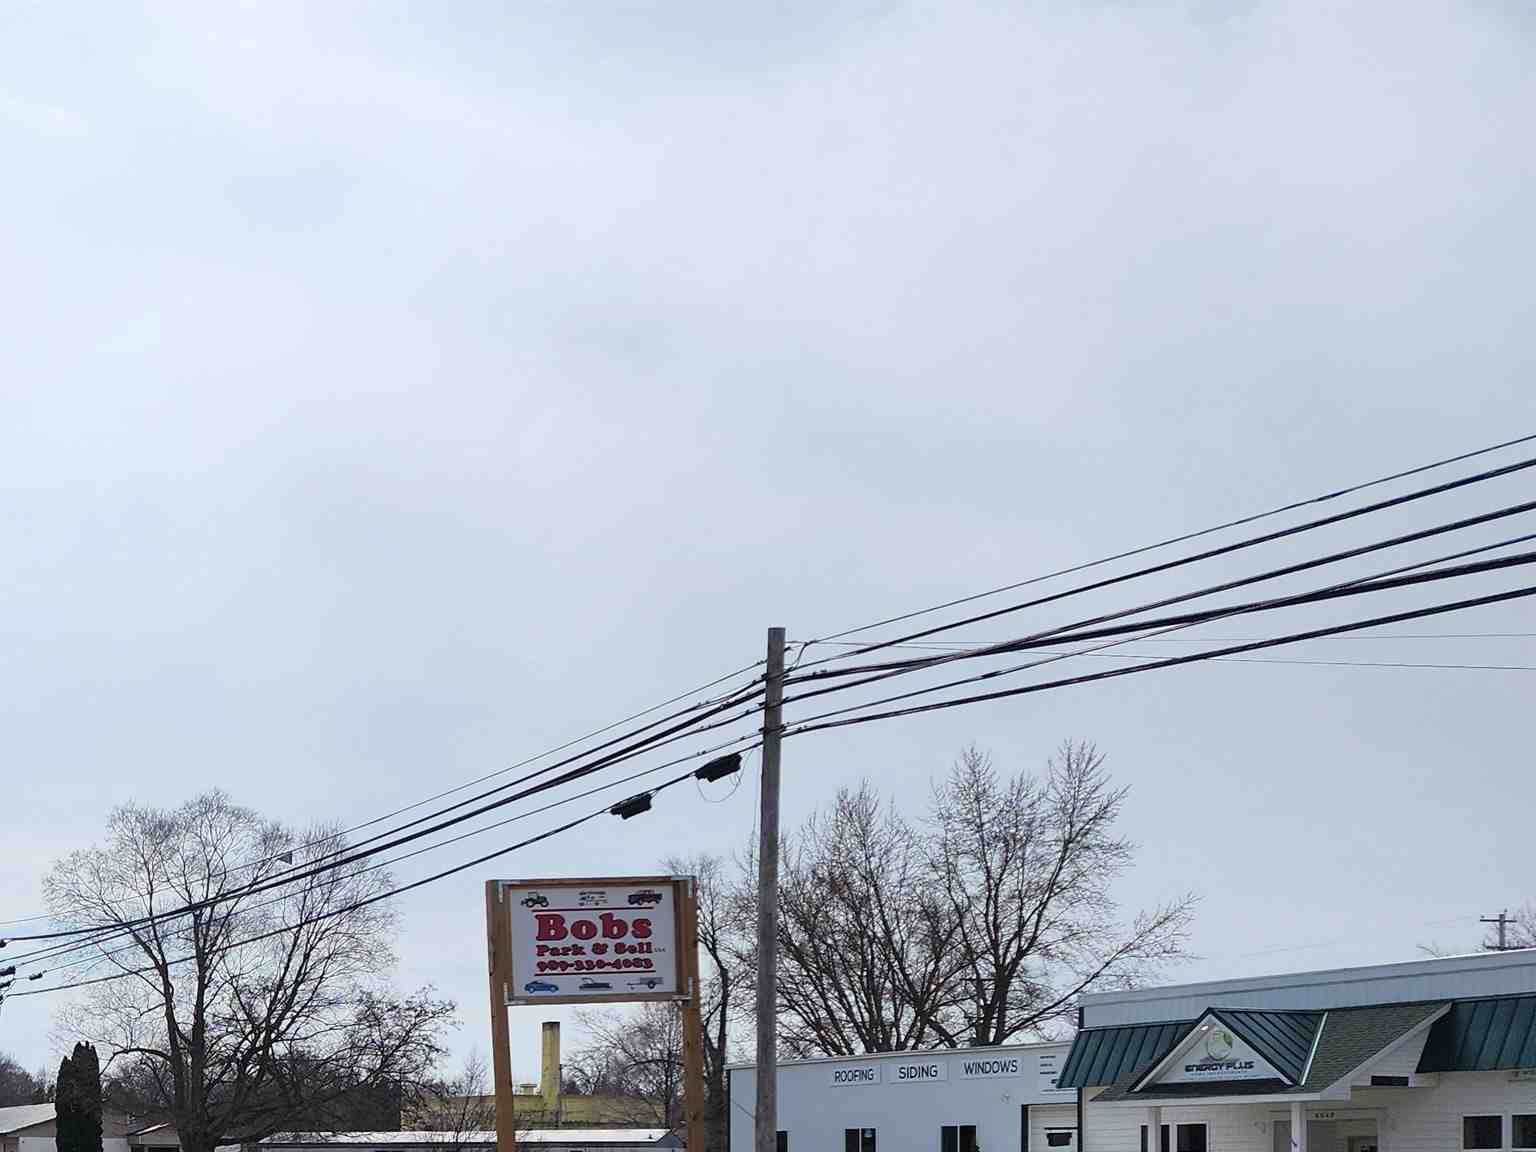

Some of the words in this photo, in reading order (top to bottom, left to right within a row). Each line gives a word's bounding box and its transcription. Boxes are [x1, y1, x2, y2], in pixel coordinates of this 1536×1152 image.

[535, 913, 652, 941] Bobs
[536, 944, 586, 957] Park
[614, 942, 652, 954] Sell
[833, 1068, 874, 1083] ROOFING
[898, 1064, 939, 1081] SIDING
[963, 1060, 1017, 1075] WINDOWS
[1185, 1063, 1225, 1073] ENERGY
[1226, 1061, 1255, 1071] PLUS
